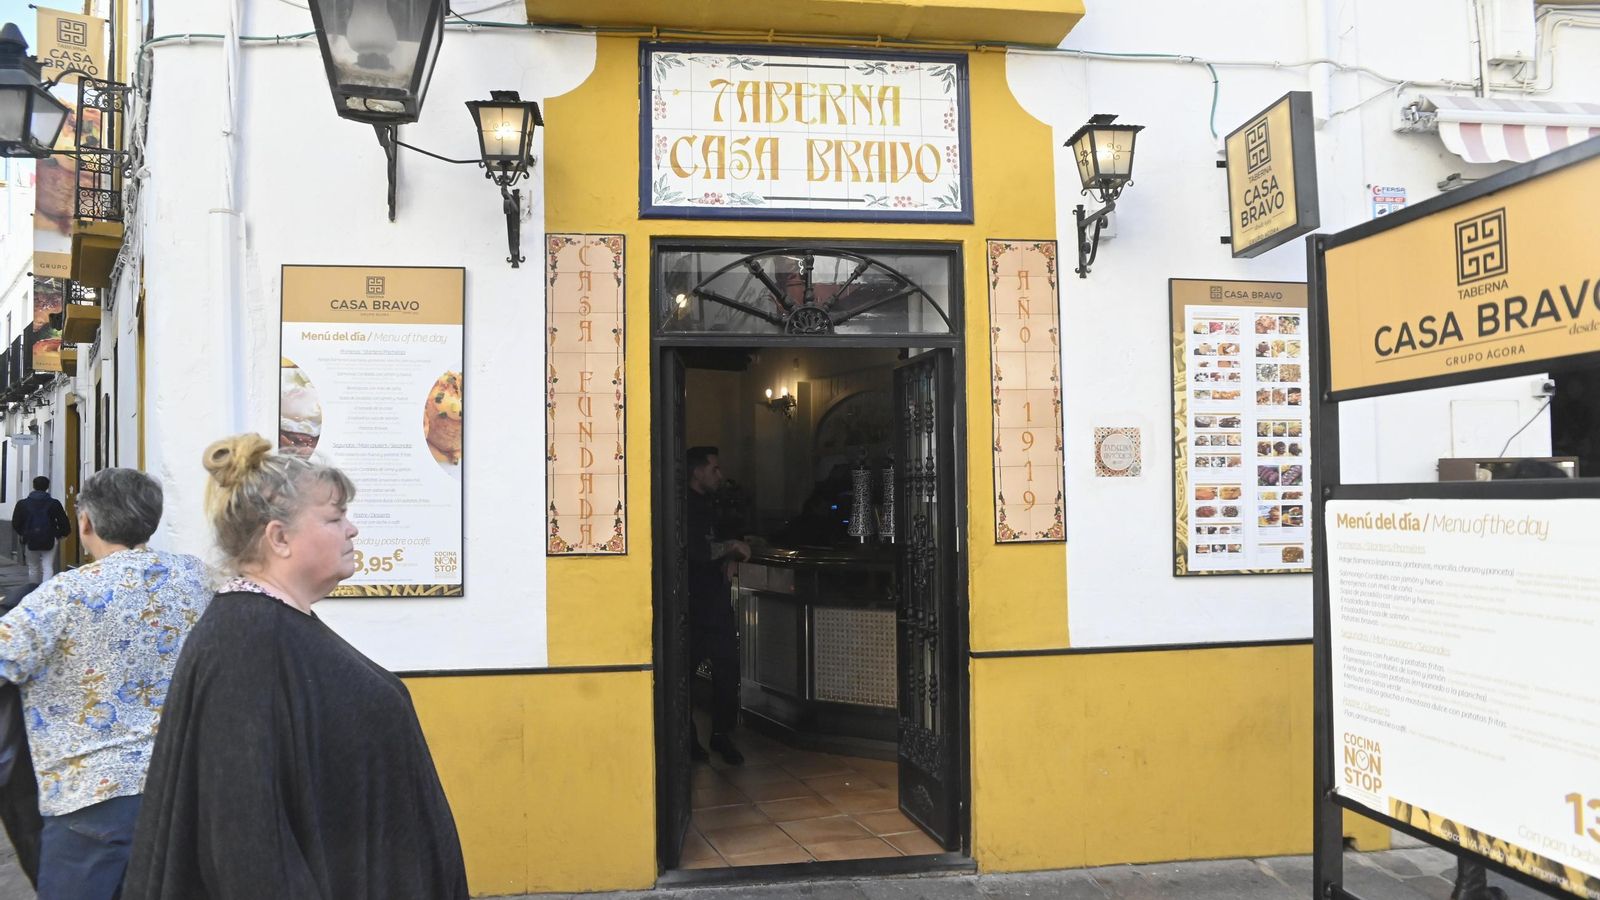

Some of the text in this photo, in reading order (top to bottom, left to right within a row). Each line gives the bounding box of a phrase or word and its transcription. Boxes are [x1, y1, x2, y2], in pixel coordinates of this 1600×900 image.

[43, 58, 98, 76] BRAVO
[49, 48, 93, 65] CASA
[709, 78, 901, 126] TABERNA
[669, 135, 941, 183] CASA BRAVO
[1248, 166, 1272, 183] TABERNA
[1244, 175, 1279, 207] CASA
[1241, 191, 1285, 228] BRAVO
[40, 263, 68, 271] GRUPO
[1224, 290, 1283, 300] CASA BRAVO
[1458, 279, 1509, 300] TABERNA
[330, 299, 420, 311] CASA BRAVO
[1374, 278, 1600, 357] CASA BRAV
[301, 330, 331, 342] Menú
[333, 330, 349, 342] del
[350, 330, 366, 342] día
[373, 332, 401, 343] Menu
[401, 332, 413, 345] of
[412, 333, 428, 343] the
[428, 333, 449, 345] day
[1445, 352, 1483, 367] GRUPO
[577, 245, 594, 546] CASA FUNDADA
[1017, 270, 1036, 511] AÑO 1919
[1336, 512, 1373, 531] Menú
[1375, 513, 1397, 531] del
[1399, 512, 1421, 532] día
[1432, 514, 1472, 533] Menu
[1472, 514, 1490, 538] of
[1490, 514, 1516, 535] the
[1517, 515, 1550, 541] day
[380, 537, 407, 547] postre
[434, 565, 457, 573] STOP
[1343, 732, 1381, 754] COCINA
[1344, 745, 1382, 776] NON
[1344, 767, 1383, 794] STOP
